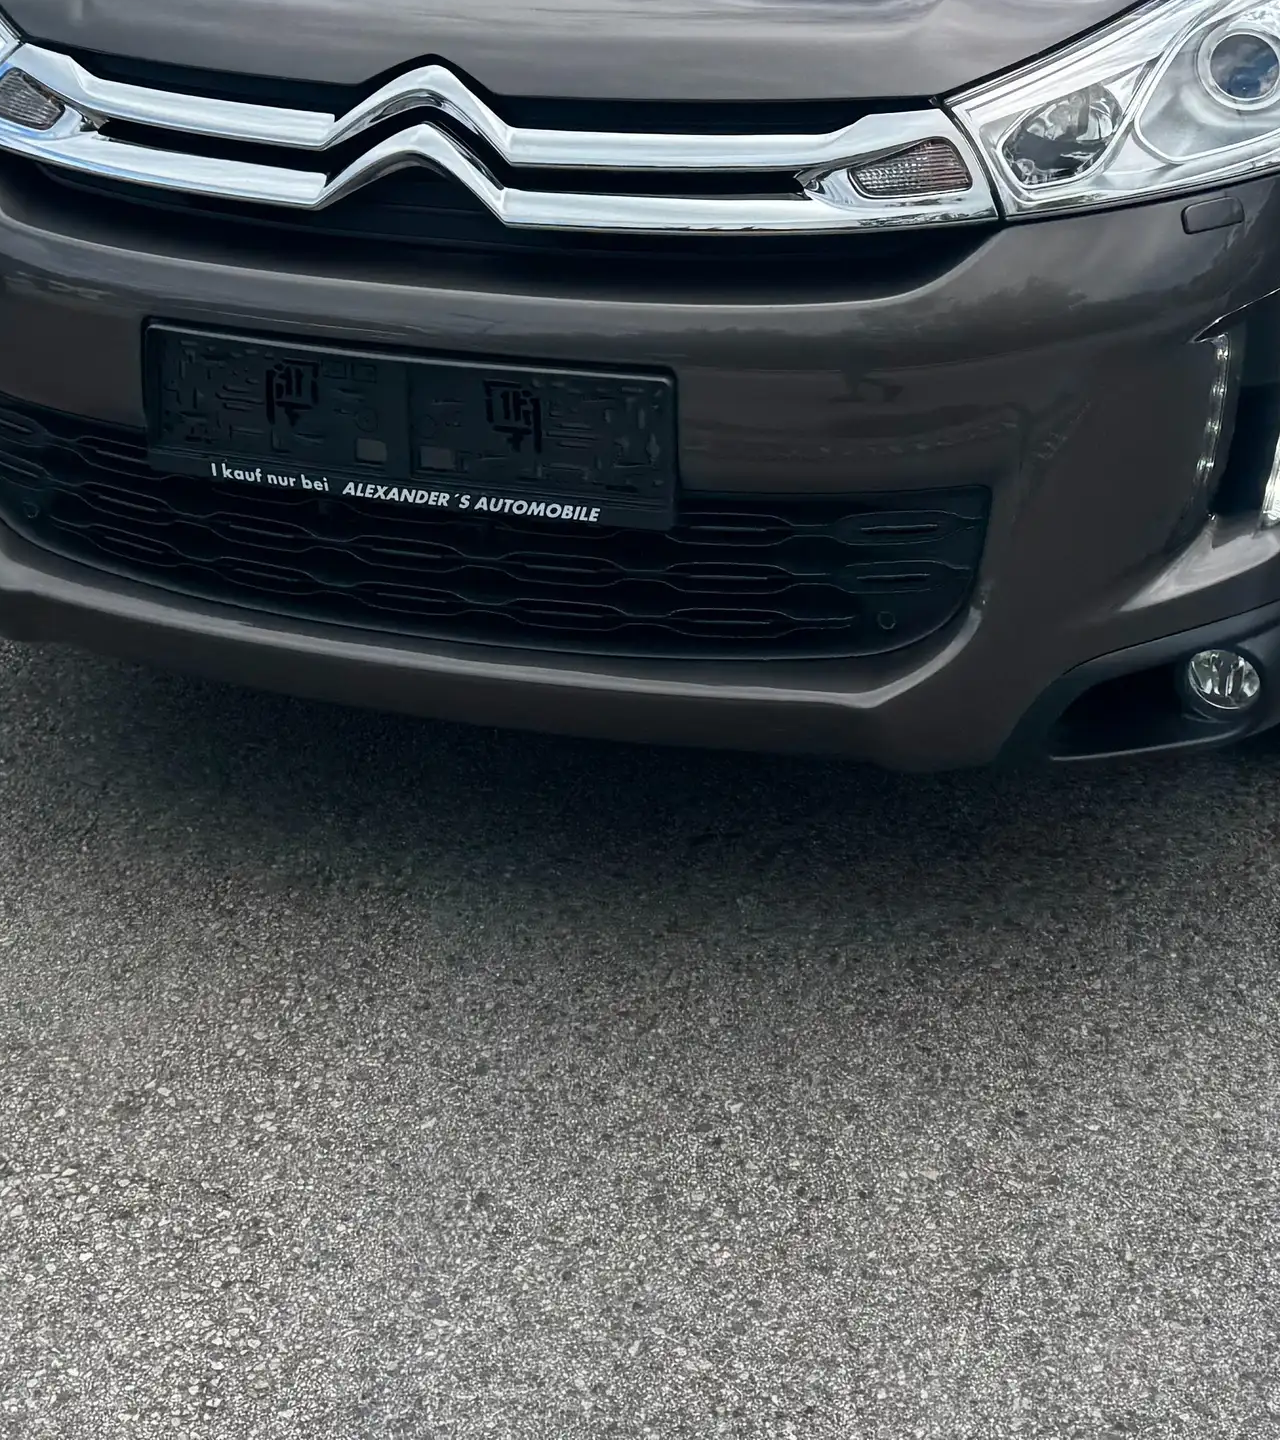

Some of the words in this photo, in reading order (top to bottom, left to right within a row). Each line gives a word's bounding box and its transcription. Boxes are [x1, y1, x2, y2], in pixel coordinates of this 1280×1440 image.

[211, 462, 217, 477] I
[221, 462, 262, 483] kauf
[266, 474, 296, 487] nur
[300, 473, 329, 492] bei
[473, 496, 601, 522] AUTOMOBILE
